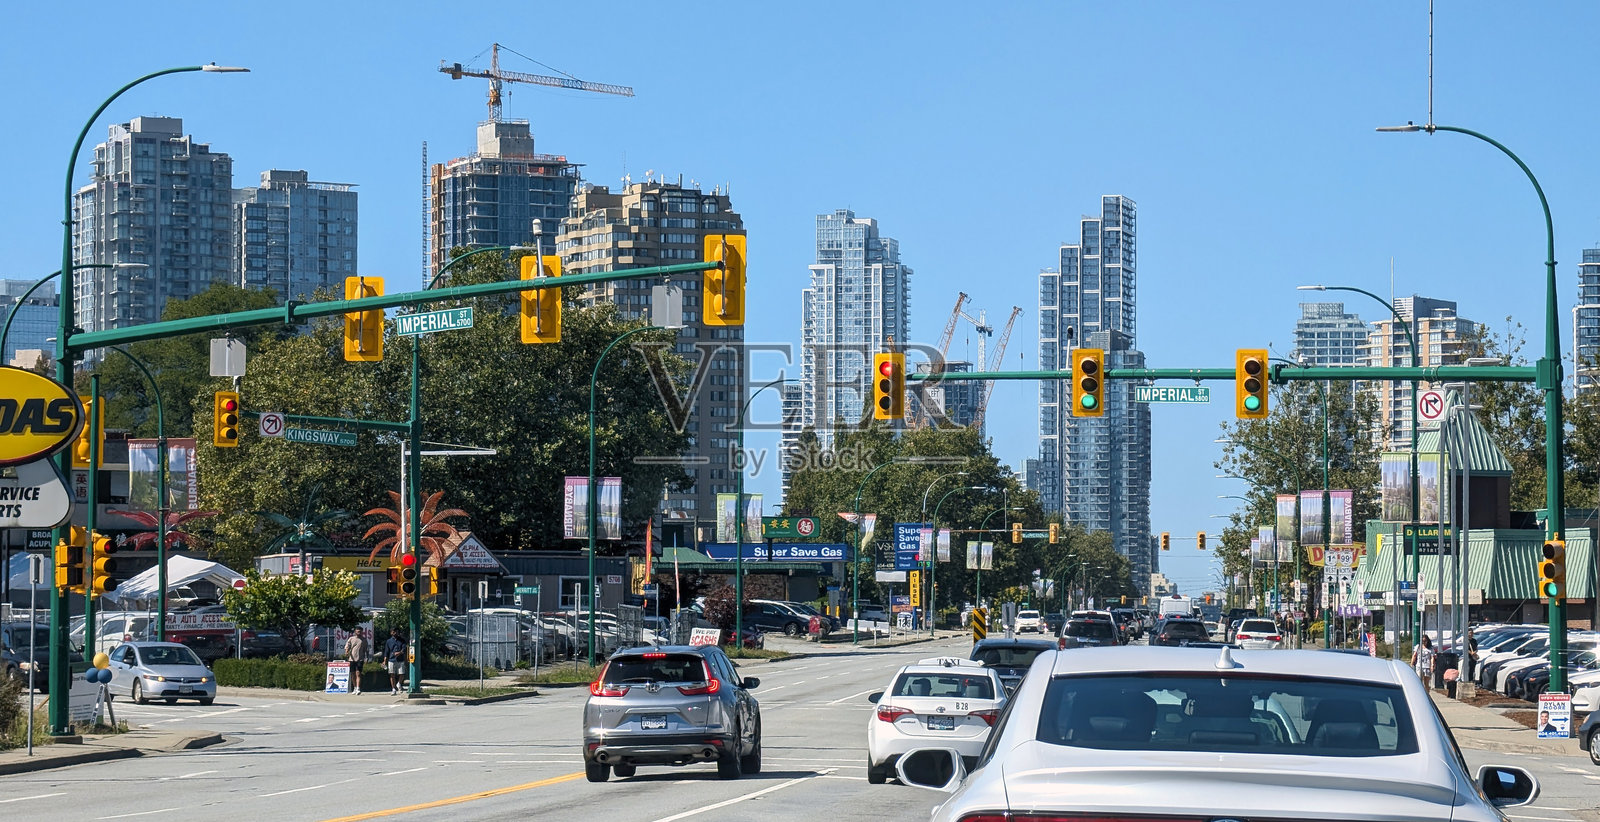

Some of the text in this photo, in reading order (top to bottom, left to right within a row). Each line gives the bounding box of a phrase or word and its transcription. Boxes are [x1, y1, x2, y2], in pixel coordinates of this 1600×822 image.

[398, 310, 467, 333] IMPERIAL ST
[457, 318, 471, 327] 5700
[1137, 389, 1194, 401] IMPERIAL
[287, 429, 340, 443] KINGSWAY
[899, 526, 920, 535] Supe
[790, 547, 818, 557] Save
[821, 547, 843, 556] Gas
[181, 615, 196, 623] AUTO
